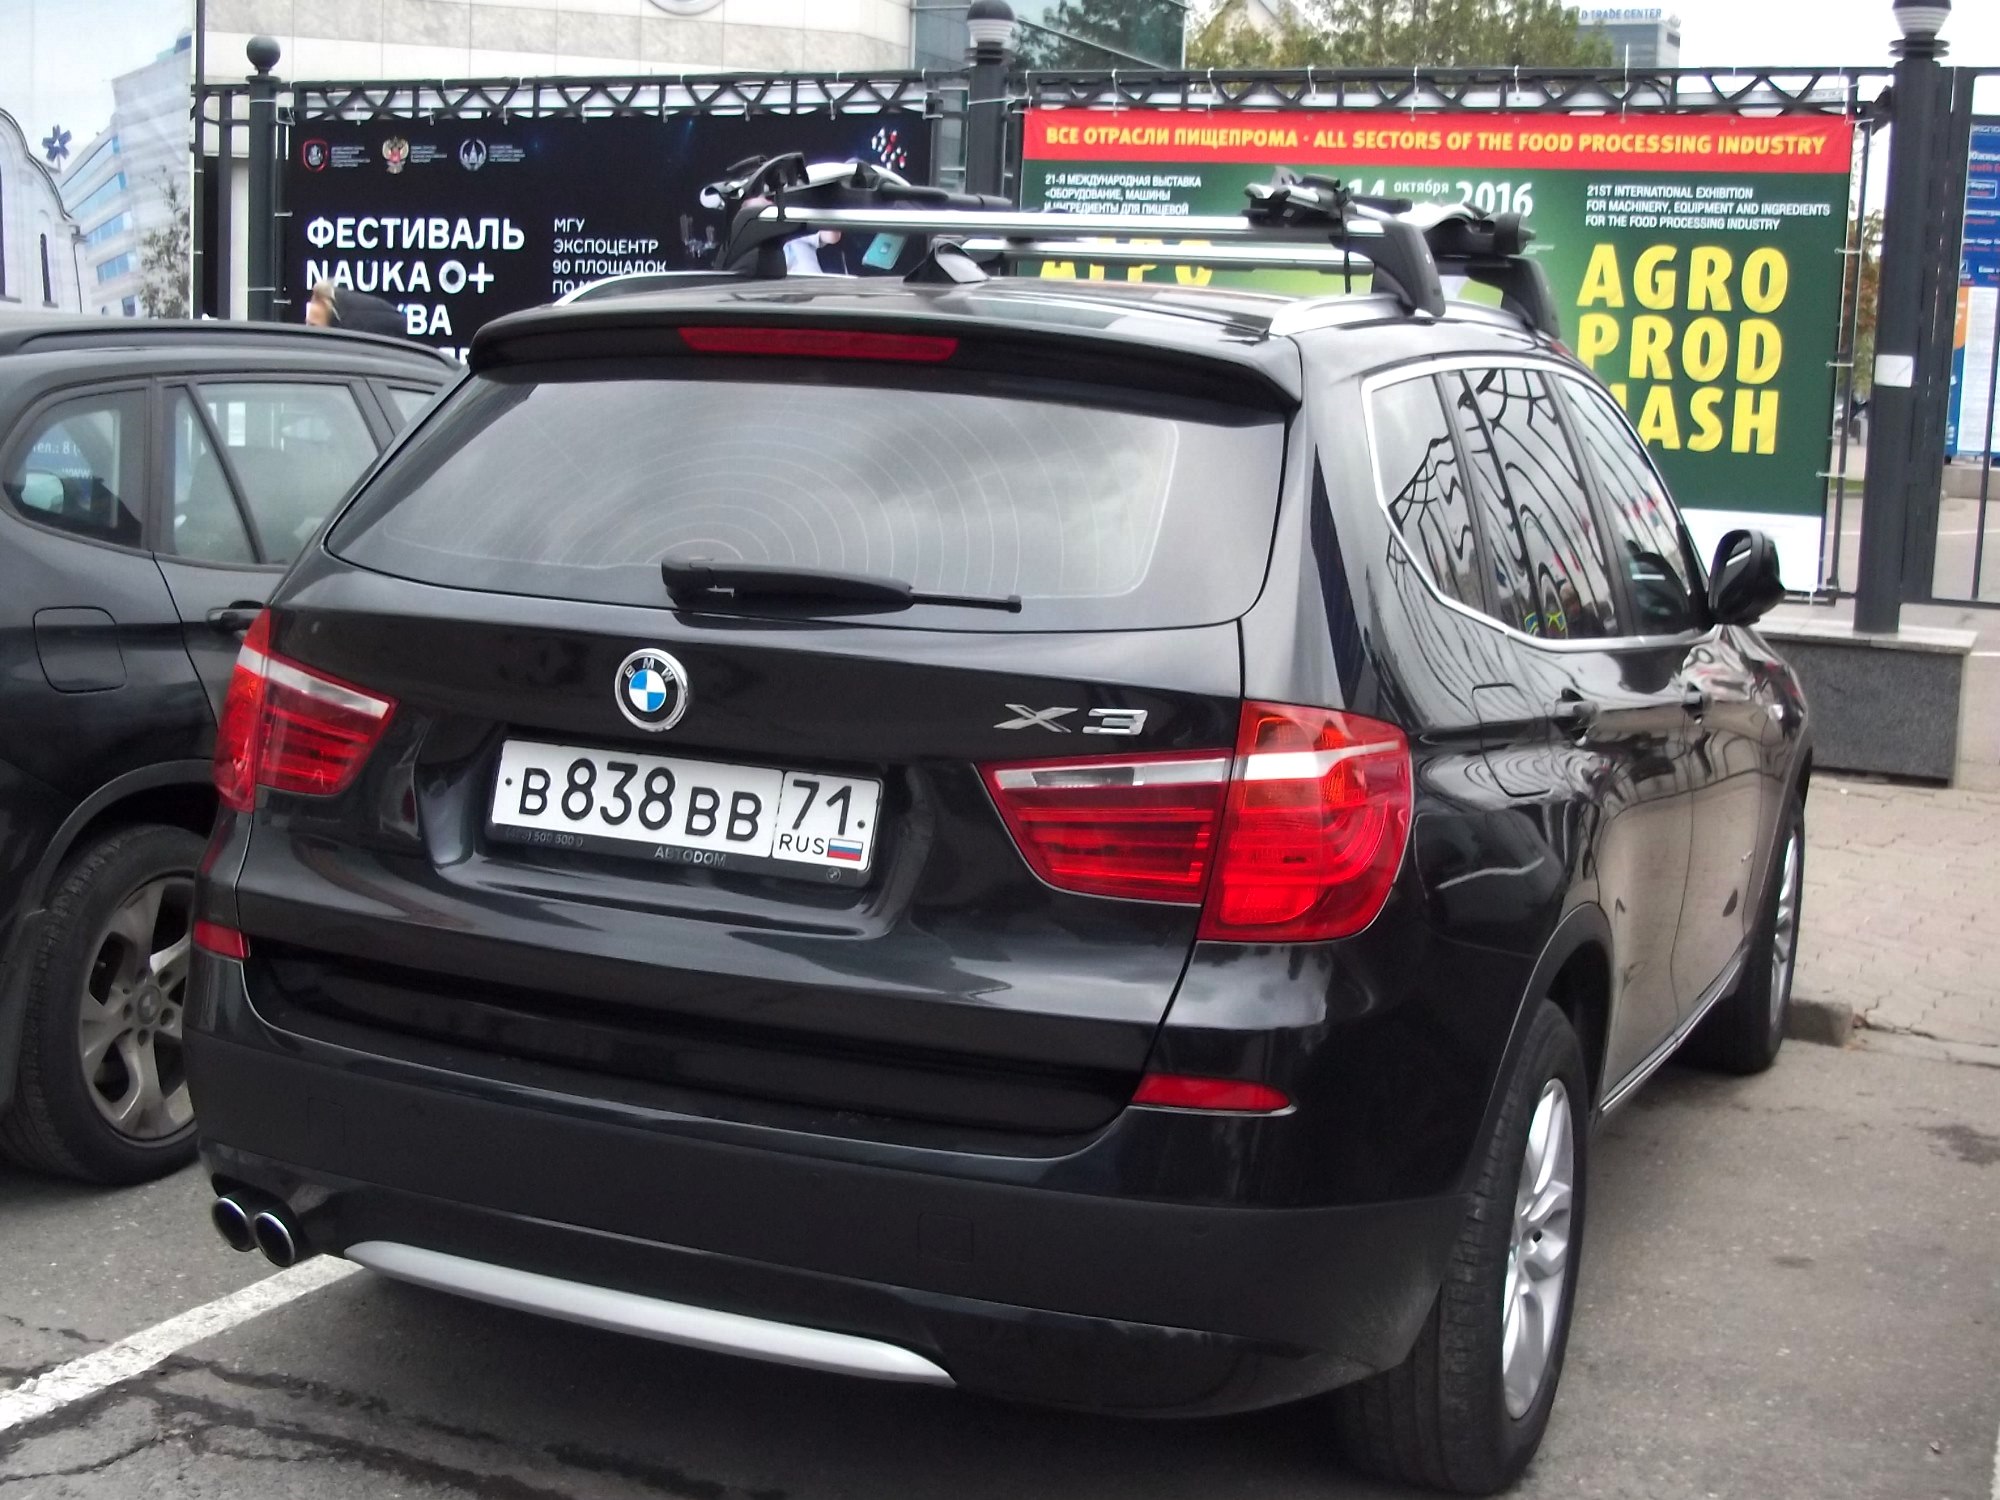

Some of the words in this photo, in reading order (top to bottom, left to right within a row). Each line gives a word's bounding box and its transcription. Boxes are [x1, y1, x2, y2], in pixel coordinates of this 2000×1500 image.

[1046, 126, 1079, 145] ВСЕ
[1083, 127, 1169, 146] ОТРАСЛИ
[1173, 128, 1298, 149] ПИЩЕПРОМА
[1313, 131, 1347, 148] ALL
[1352, 130, 1442, 150] SECTORS
[1446, 131, 1473, 149] OF
[1478, 132, 1513, 151] THE
[1518, 133, 1573, 152] FOOD
[1578, 134, 1712, 153] PROCESSING
[1717, 136, 1826, 155] INDUSTRY
[1045, 174, 1066, 185] 21-Я
[1067, 174, 1151, 187] МЕЖДУНАРОДНАЯ
[1152, 175, 1202, 187] ВЫСТАВКА
[1587, 185, 1612, 197] 21ST
[1614, 185, 1693, 198] INTERNATIONAL
[1696, 187, 1753, 199] EXHIBITION
[1125, 189, 1171, 201] МАШИНЫ
[1394, 180, 1449, 196] октября
[1456, 181, 1534, 217] 2016
[1120, 203, 1141, 216] ДЛЯ
[1141, 203, 1190, 216] ПИЩЕВОЙ
[1586, 201, 1607, 212] FOR
[1609, 202, 1672, 215] MACHINERY,
[1673, 203, 1734, 215] EQUIPMENT
[1736, 204, 1759, 216] AND
[1761, 204, 1830, 216] INGREDIENTS
[306, 217, 526, 251] ФЕСТИВАЛЬ
[554, 219, 585, 233] МГУ
[1585, 216, 1606, 227] FOR
[1608, 216, 1628, 228] THE
[1630, 217, 1658, 229] FOOD
[1660, 218, 1725, 230] PROCESSING
[1727, 219, 1780, 231] INDUSTRY
[553, 240, 660, 257] ЭКСПОЦЕНТР
[306, 260, 431, 293] NAUKA
[552, 260, 569, 275] 90
[574, 260, 668, 276] ПЛОЩАДОК
[1576, 244, 1789, 314] AGRO
[1577, 314, 1783, 385] PROD
[1612, 384, 1780, 455] ASH
[625, 657, 675, 682] BMW
[993, 703, 1148, 735] X3
[791, 779, 852, 836] 71
[778, 833, 824, 855] RUS
